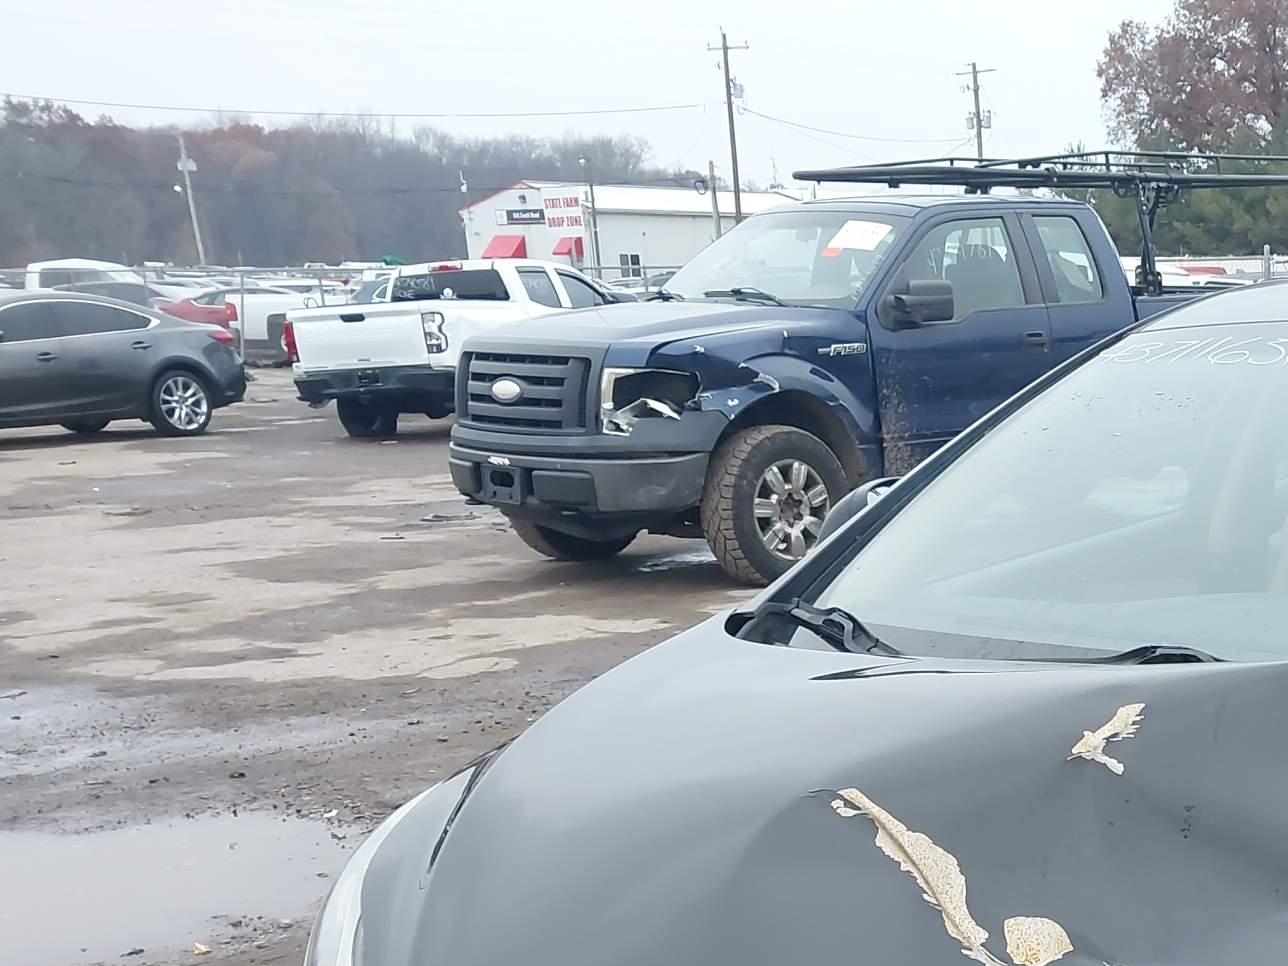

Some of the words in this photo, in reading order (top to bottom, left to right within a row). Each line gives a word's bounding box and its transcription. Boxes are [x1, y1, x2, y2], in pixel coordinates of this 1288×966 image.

[544, 198, 562, 209] STATE
[562, 197, 580, 208] FARM
[547, 217, 565, 228] DROP
[566, 216, 583, 227] ZONE
